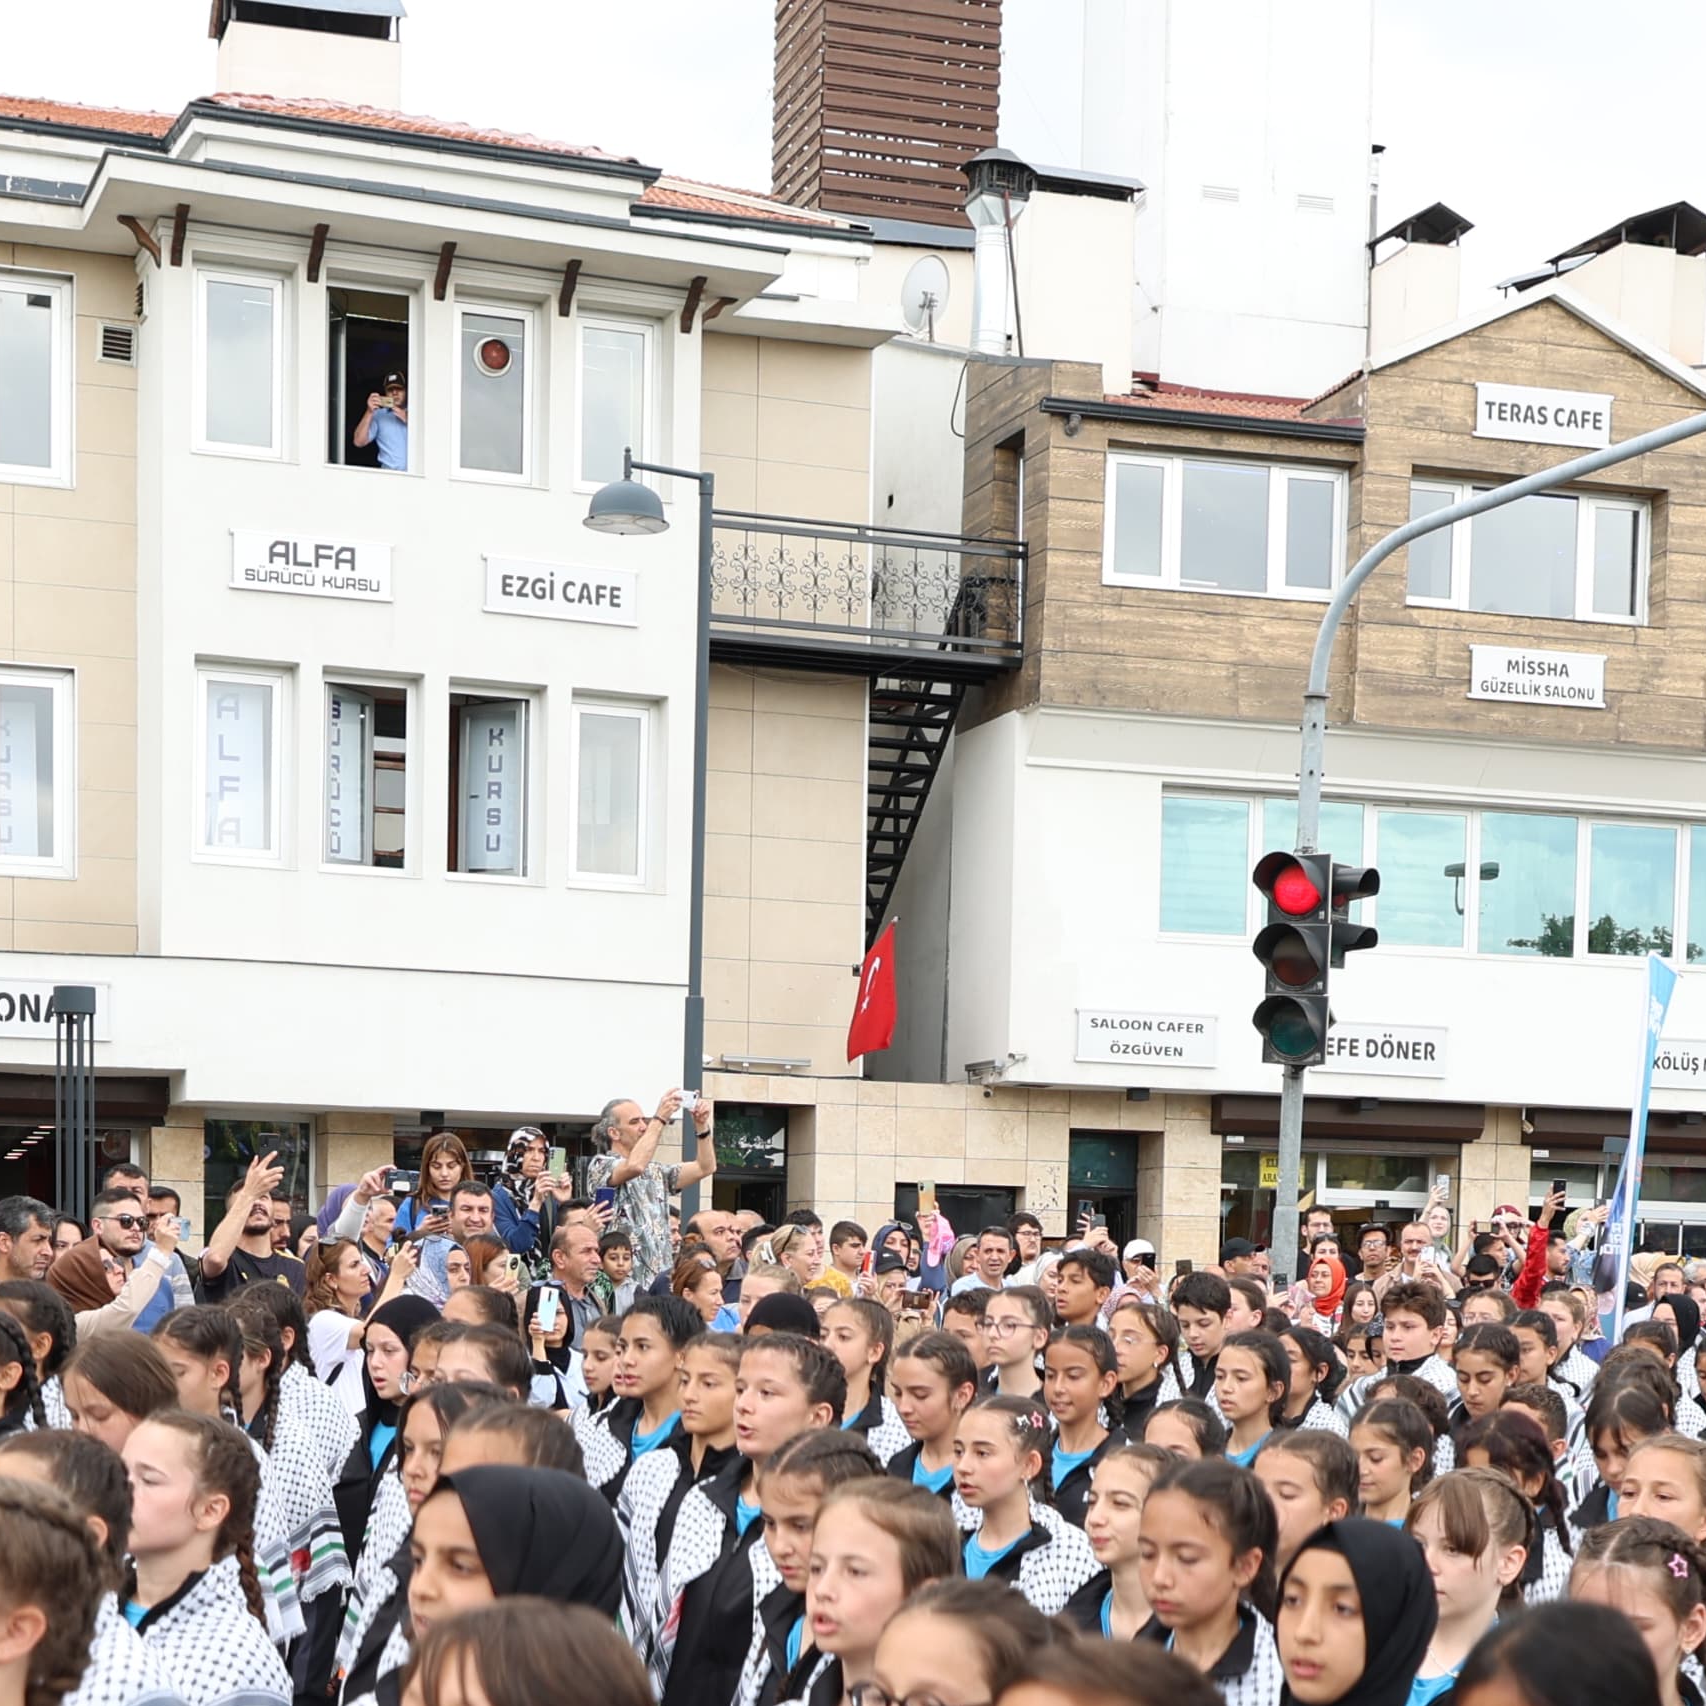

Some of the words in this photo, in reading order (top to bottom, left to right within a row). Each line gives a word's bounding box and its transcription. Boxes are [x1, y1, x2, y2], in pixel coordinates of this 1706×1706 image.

[1484, 400, 1548, 426] TERAS
[1553, 407, 1603, 431] CAFE
[268, 540, 356, 572] ALFA
[244, 565, 316, 587] SÜRÜCÜ
[322, 575, 381, 593] KURSU
[501, 571, 555, 601] EZGİ
[561, 580, 622, 608] CAFE
[1507, 656, 1570, 678] MİSSHA
[1480, 676, 1542, 697] GÜZELLİK
[1544, 685, 1596, 701] SALONU
[216, 692, 241, 844] ALFA
[485, 727, 504, 853] KURSU
[1090, 1017, 1154, 1032] SALOON
[1156, 1021, 1205, 1034] CAFER
[1109, 1040, 1184, 1057] ÖZGÜVEN
[1366, 1034, 1436, 1061] DÖNER
